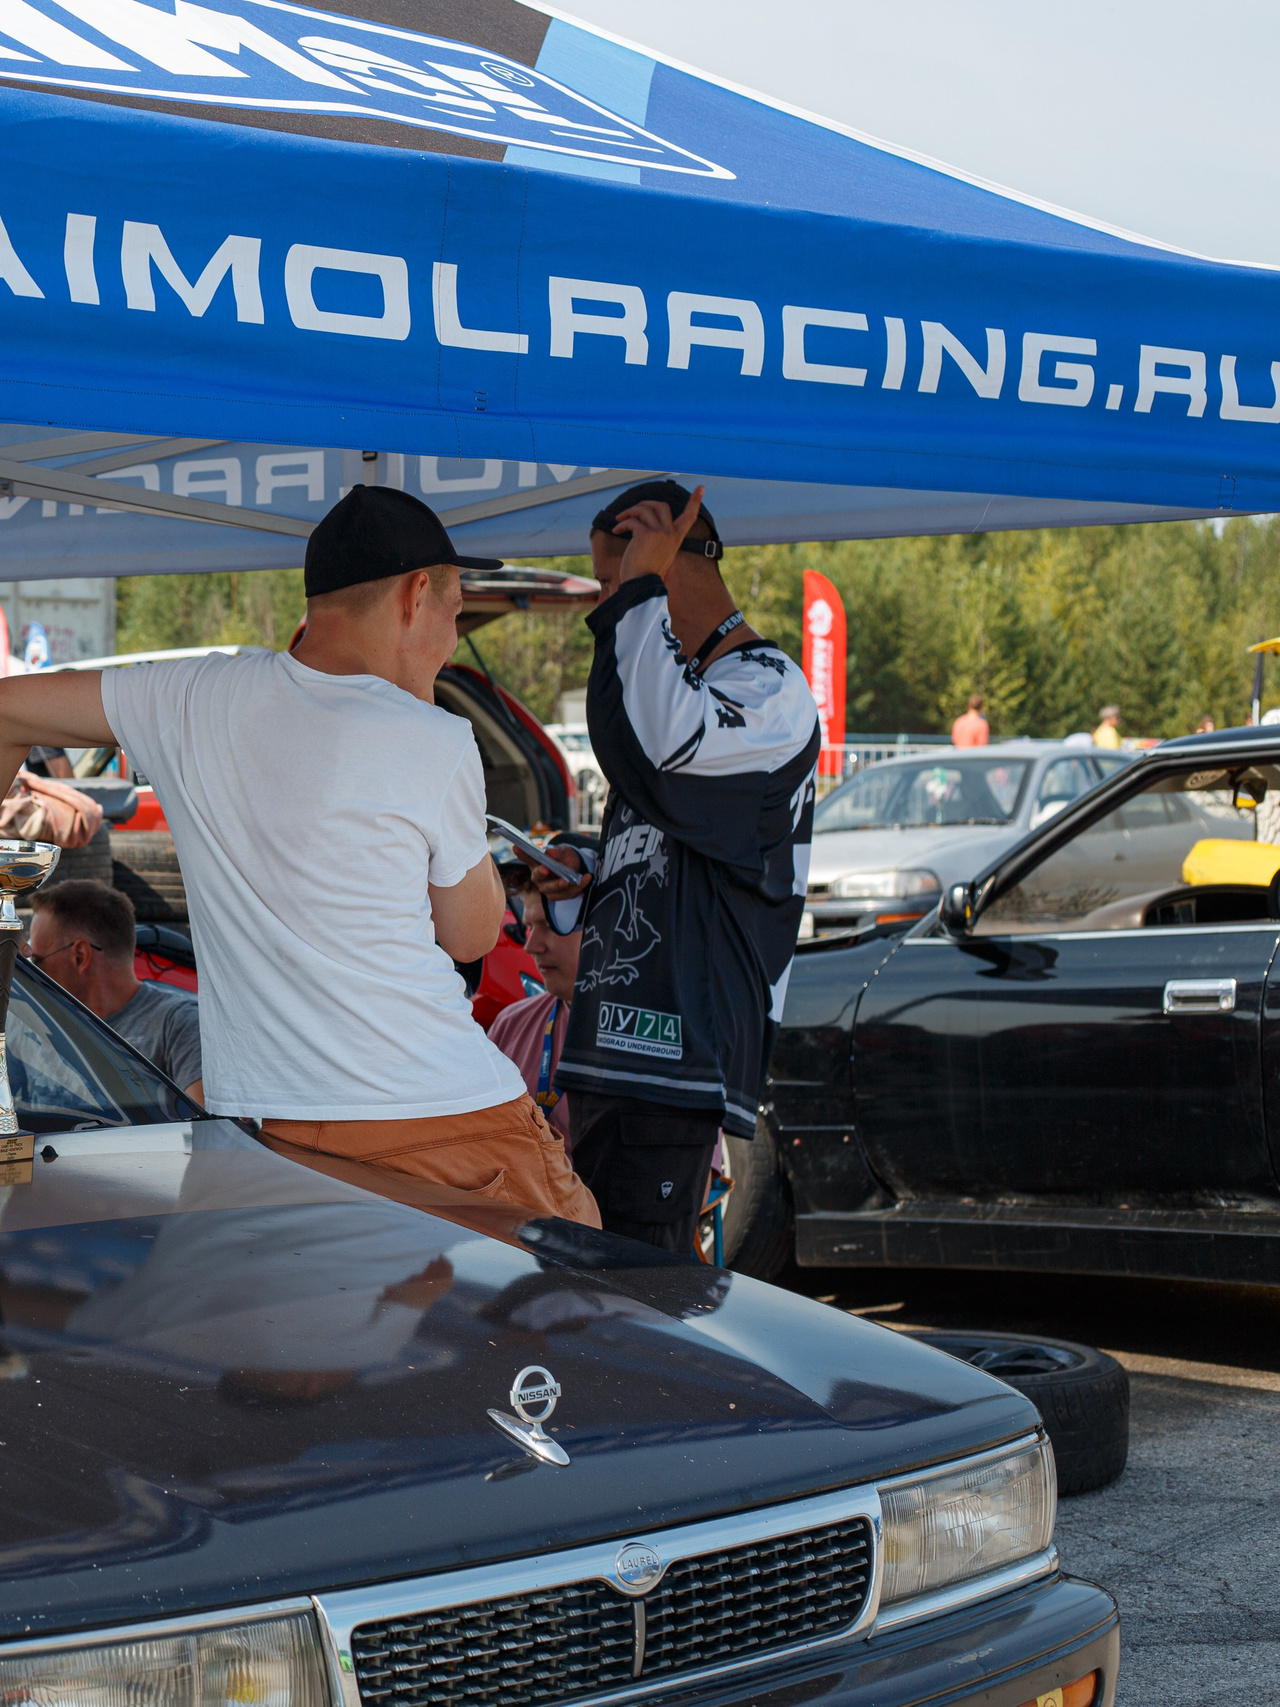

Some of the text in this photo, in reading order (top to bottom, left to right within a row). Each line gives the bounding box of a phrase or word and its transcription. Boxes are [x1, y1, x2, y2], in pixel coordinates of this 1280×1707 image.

[627, 1042, 681, 1057] UNDERGROUND
[518, 1386, 558, 1402] NISSAN
[621, 1555, 658, 1570] LAUREL
